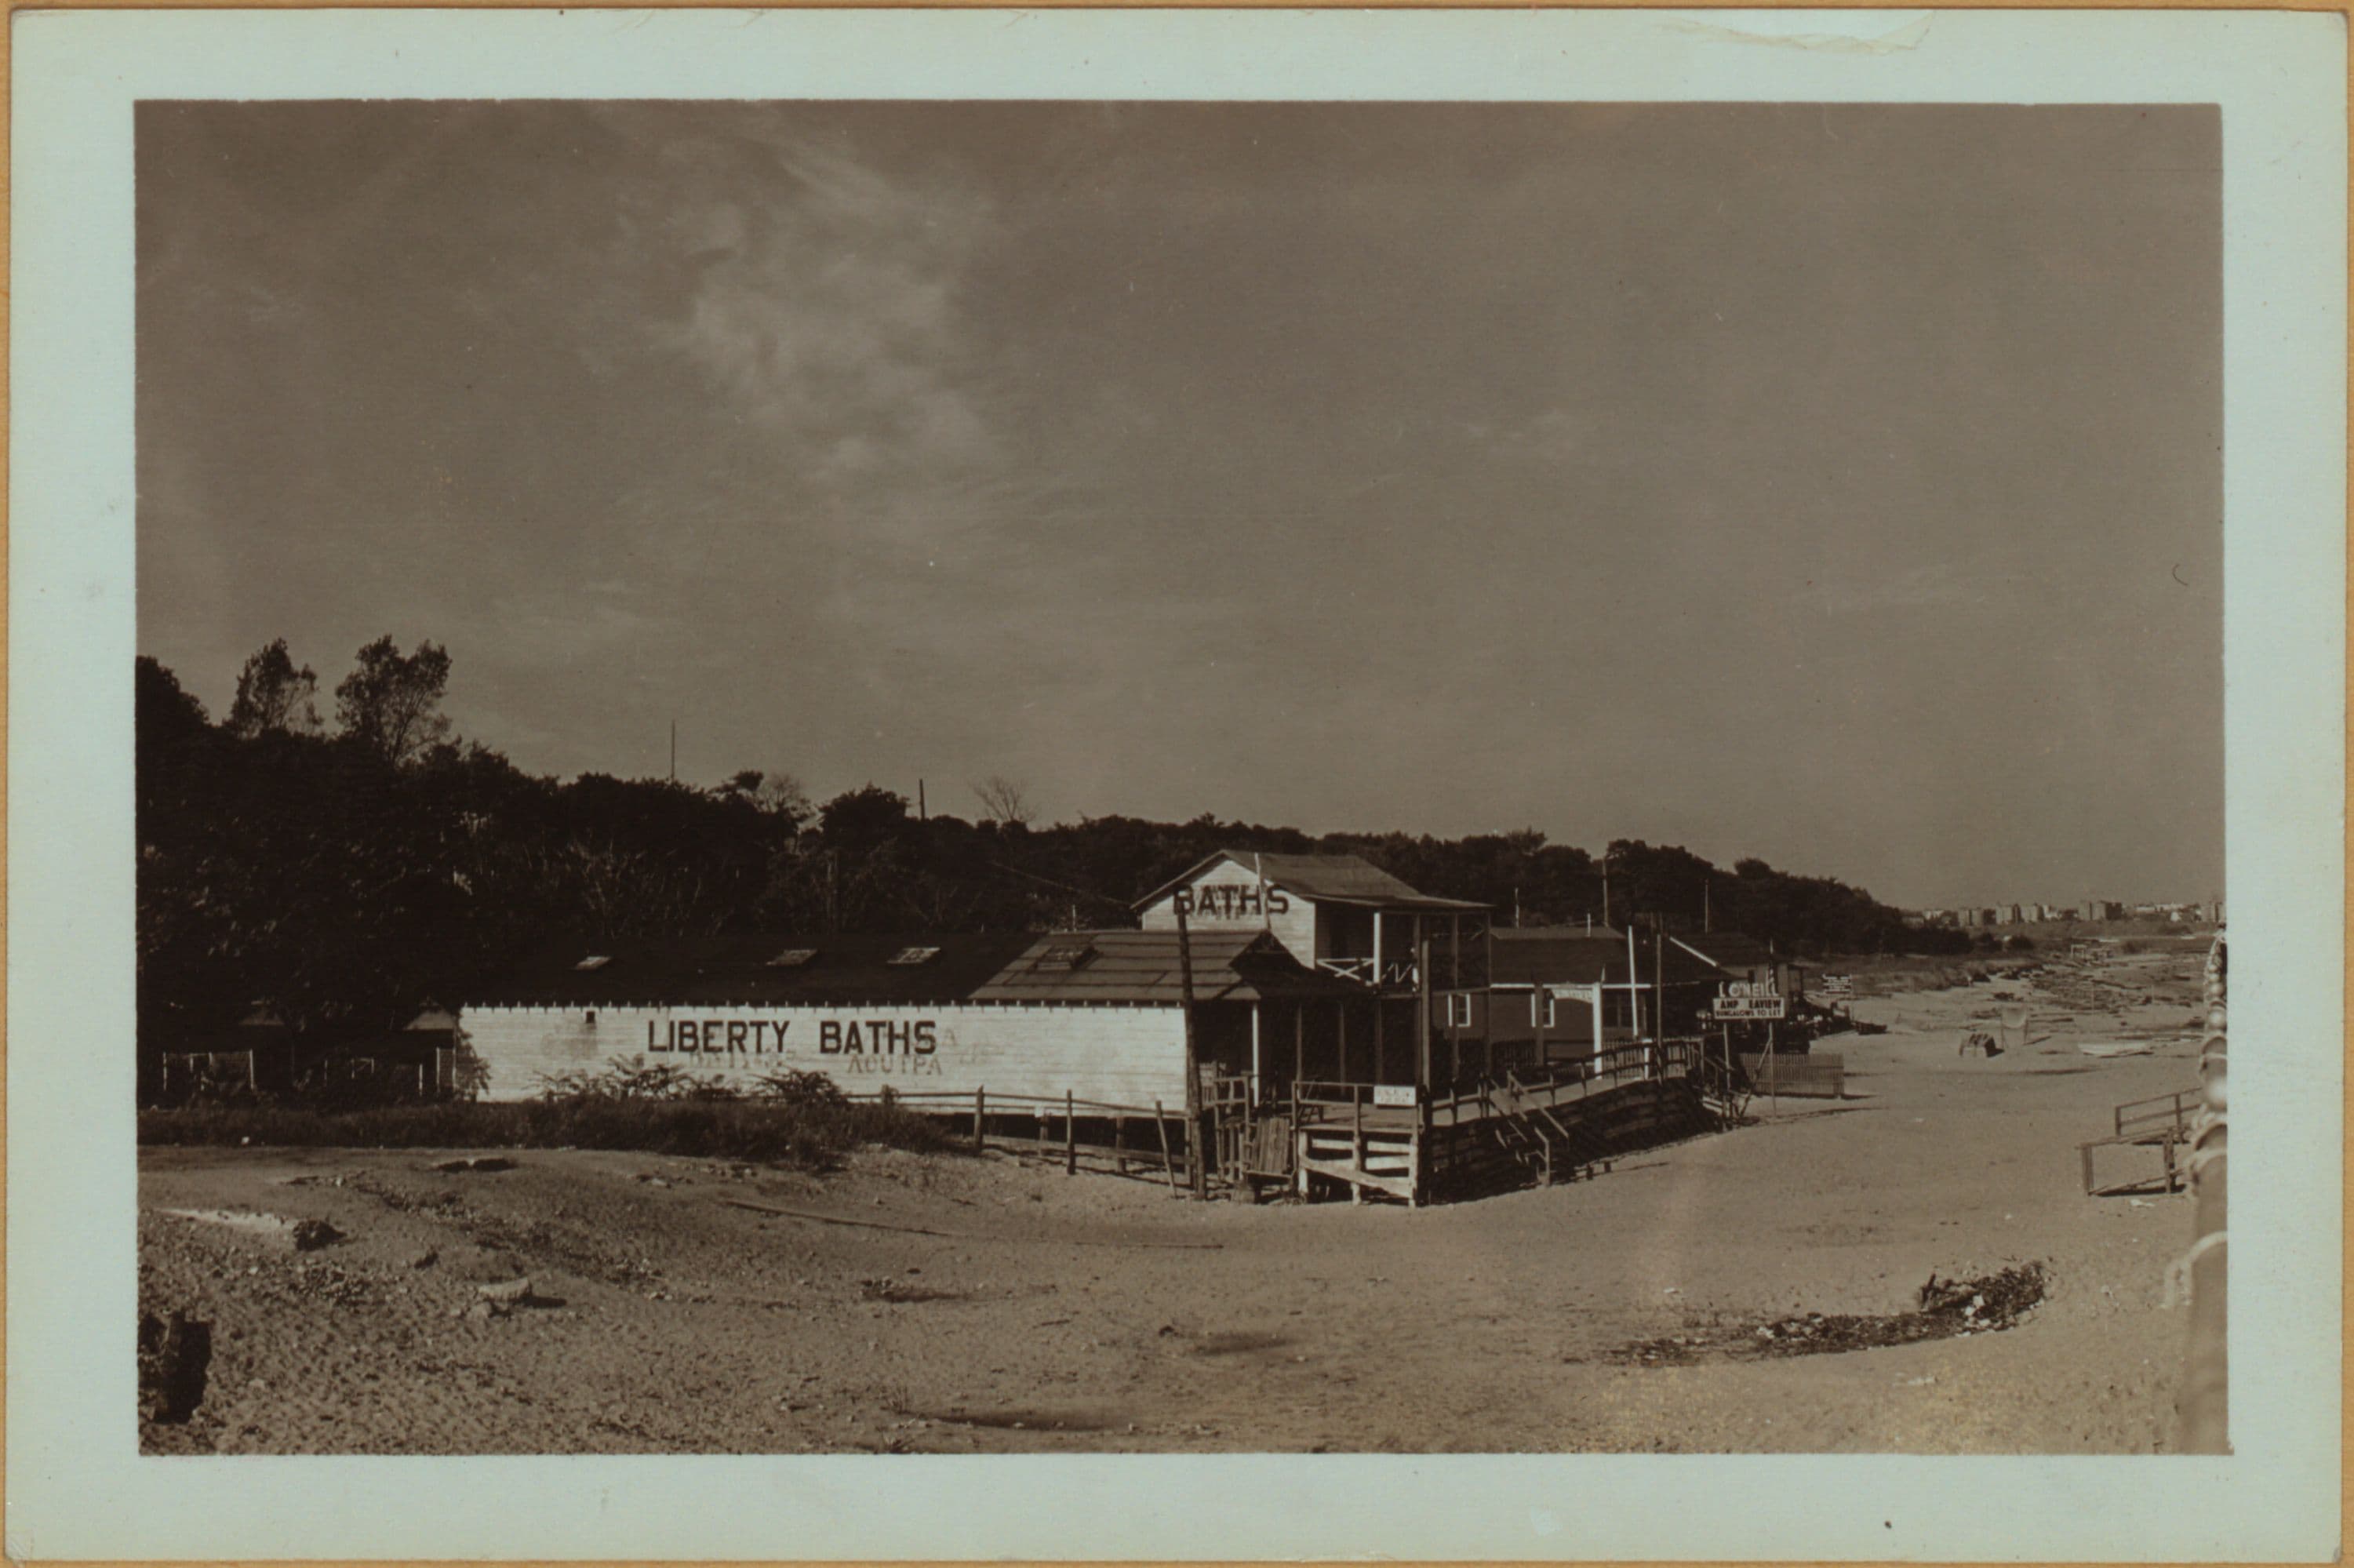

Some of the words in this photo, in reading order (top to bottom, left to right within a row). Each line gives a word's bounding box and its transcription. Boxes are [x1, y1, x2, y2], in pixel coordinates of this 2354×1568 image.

[1173, 884, 1289, 915] BATHS
[649, 1020, 790, 1052] LIBERTY
[820, 1020, 937, 1054] BATHS
